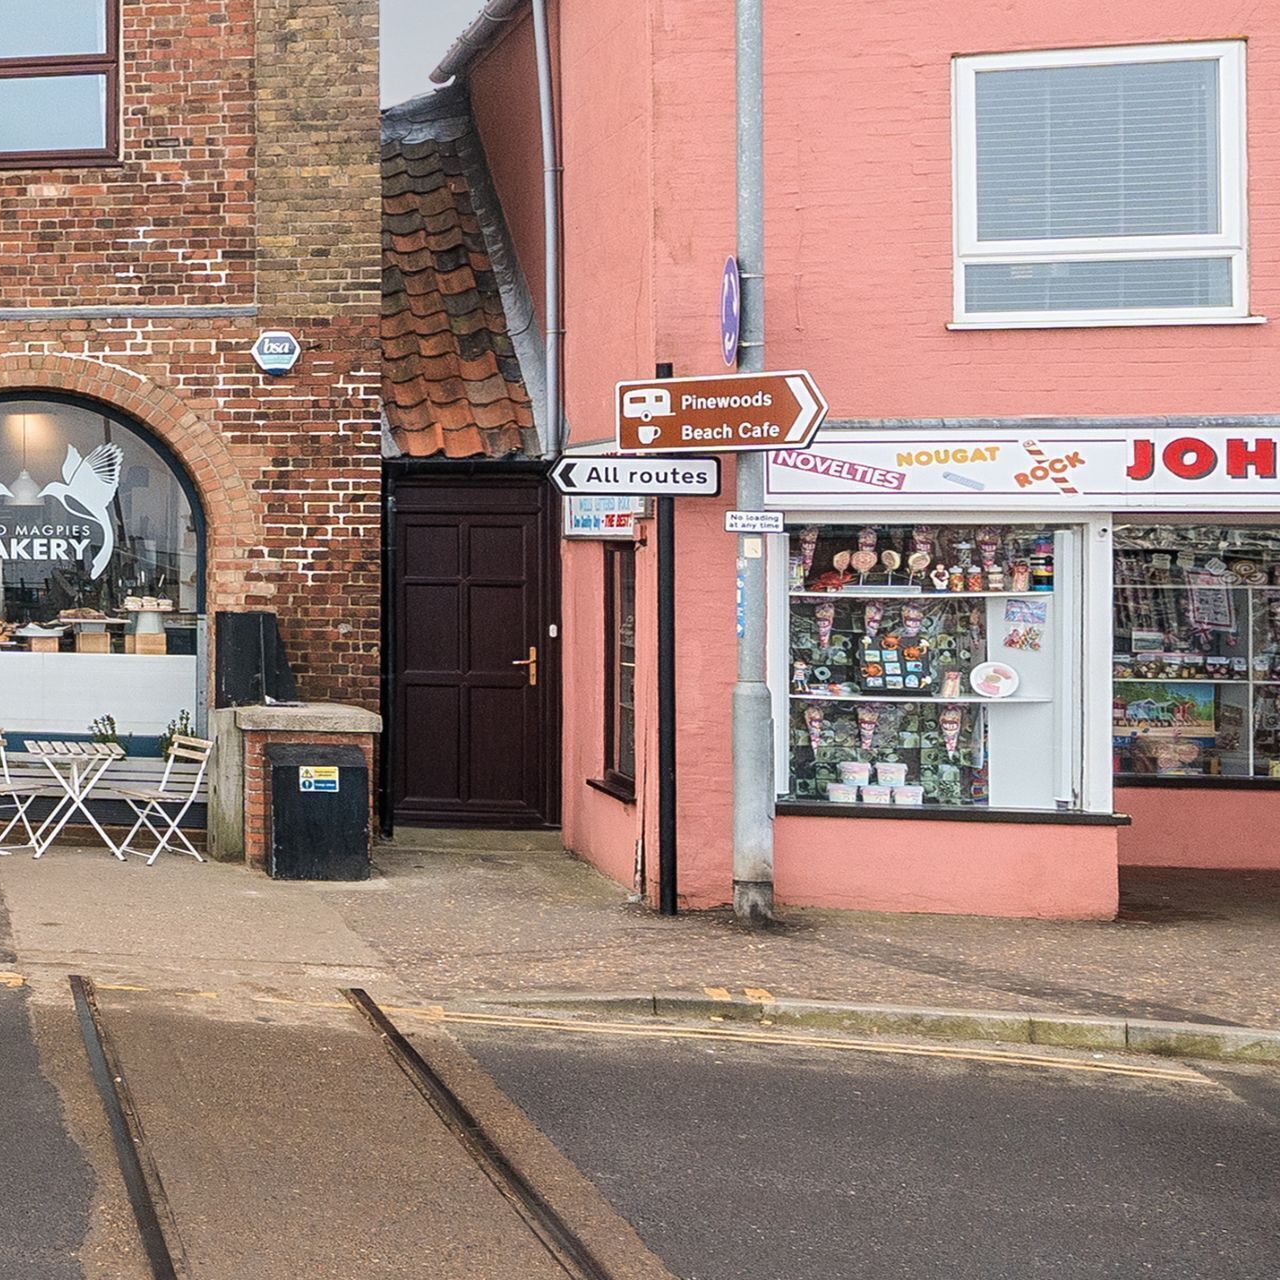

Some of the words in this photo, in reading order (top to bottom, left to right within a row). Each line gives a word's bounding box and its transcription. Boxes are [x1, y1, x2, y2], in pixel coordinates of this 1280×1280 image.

[263, 338, 290, 354] bsa
[681, 391, 772, 410] Pinewoods
[681, 424, 733, 440] Beach
[738, 422, 780, 439] Cafe
[896, 446, 1000, 467] NOUGAT
[1126, 436, 1278, 481] JOH
[586, 467, 619, 483] All
[629, 468, 707, 484] routes
[777, 450, 901, 490] NOVELTIES
[1013, 451, 1086, 488] ROCK
[746, 514, 779, 522] loading
[15, 524, 91, 536] MAGPIES
